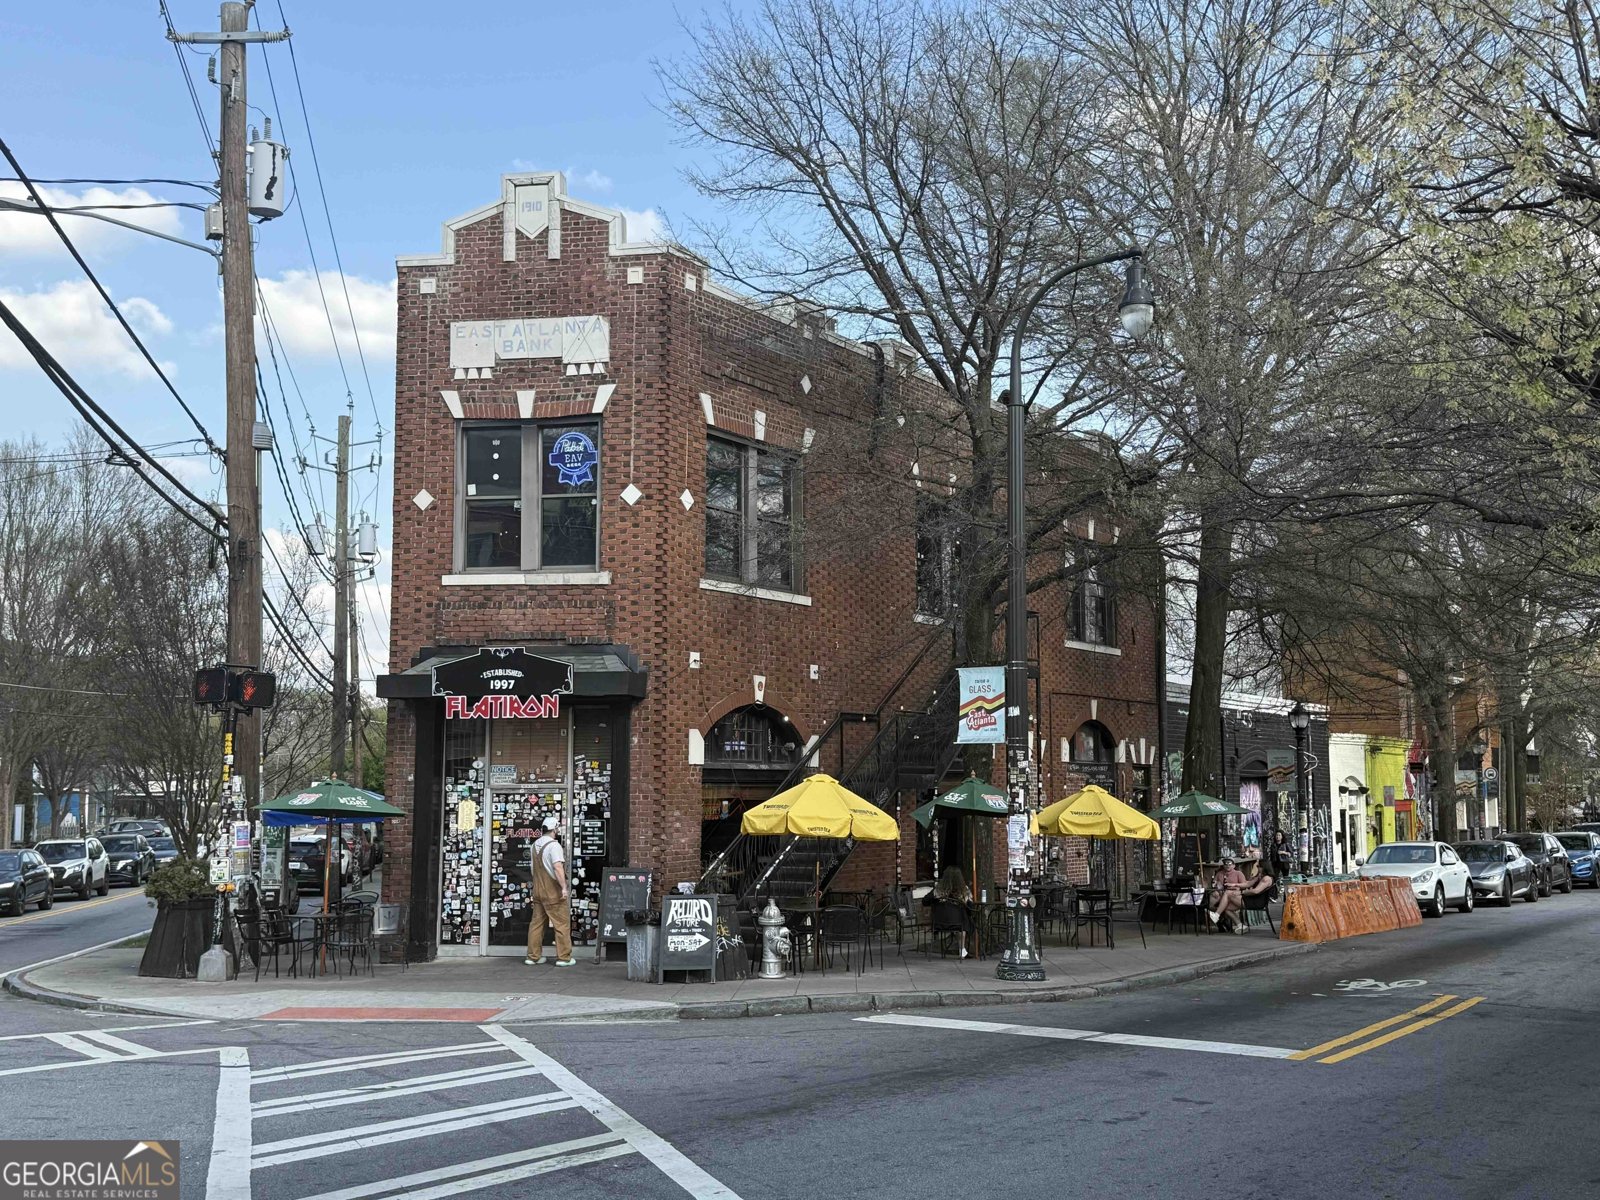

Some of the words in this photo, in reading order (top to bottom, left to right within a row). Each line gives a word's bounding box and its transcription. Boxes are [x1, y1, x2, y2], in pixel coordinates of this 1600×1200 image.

[521, 200, 543, 213] 1910
[455, 324, 506, 339] EAST
[512, 320, 603, 337] ATLANTA
[502, 338, 553, 353] BANK
[564, 453, 584, 463] EAV
[482, 668, 523, 679] ESTABLISHED
[489, 679, 516, 690] 1997
[969, 685, 991, 693] GLASS
[445, 694, 559, 720] FLATIRON
[968, 708, 987, 718] East
[967, 716, 995, 728] Atlanta
[506, 828, 543, 838] FLATIRO
[666, 899, 712, 926] RECORD
[676, 919, 700, 927] STORE
